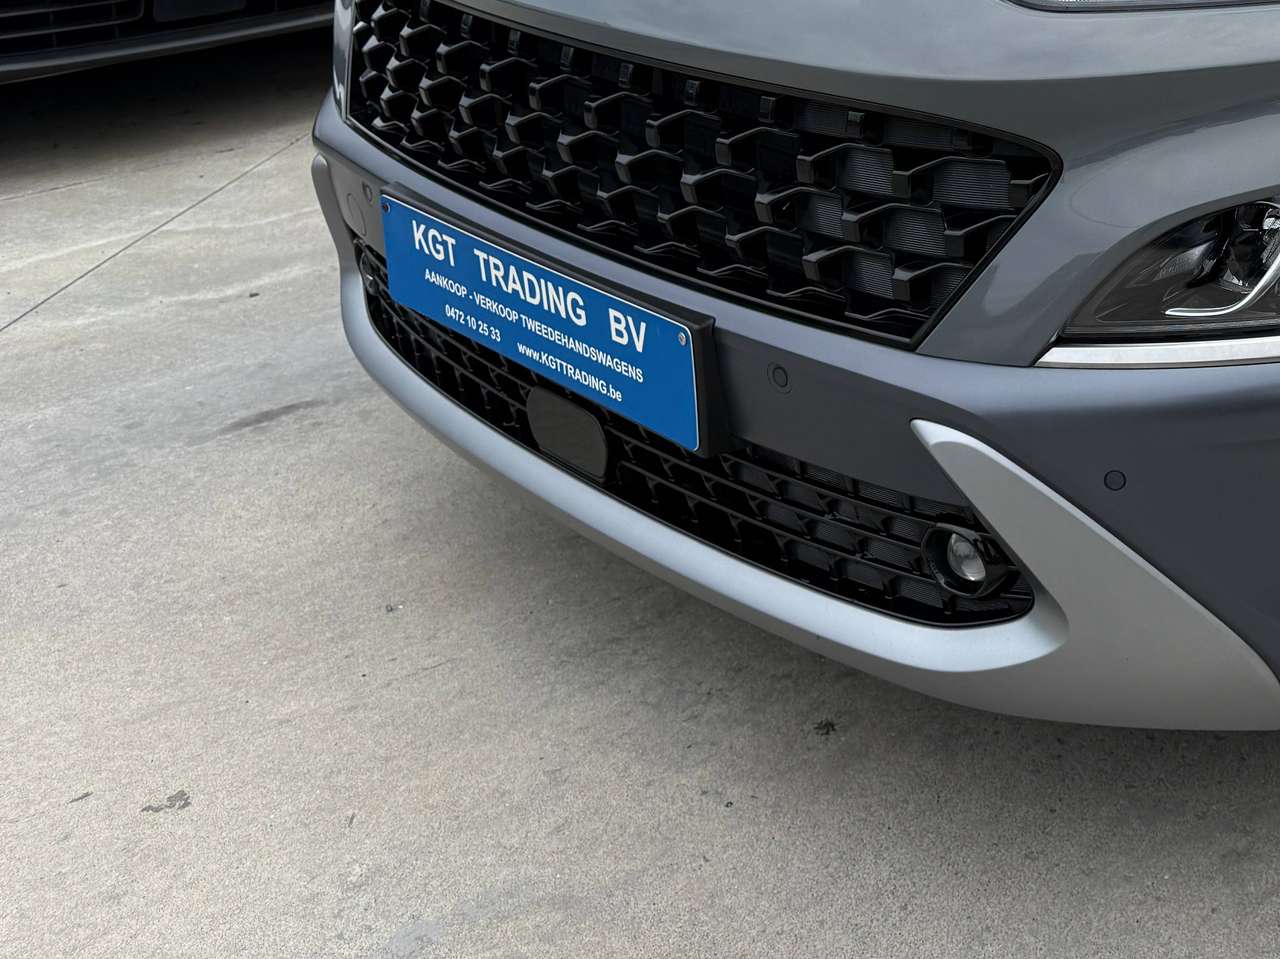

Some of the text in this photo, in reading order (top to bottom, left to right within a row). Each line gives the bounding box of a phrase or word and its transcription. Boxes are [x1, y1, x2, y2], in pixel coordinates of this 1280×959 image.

[412, 219, 647, 353] KGT TRADING BV
[424, 268, 468, 299] AANKOOP
[473, 292, 519, 323] VERKOOP
[520, 313, 644, 384] TWEEDEHANDSWAGENS
[445, 304, 623, 403] 0472 10 25 33 www.KGTTRADING.be
